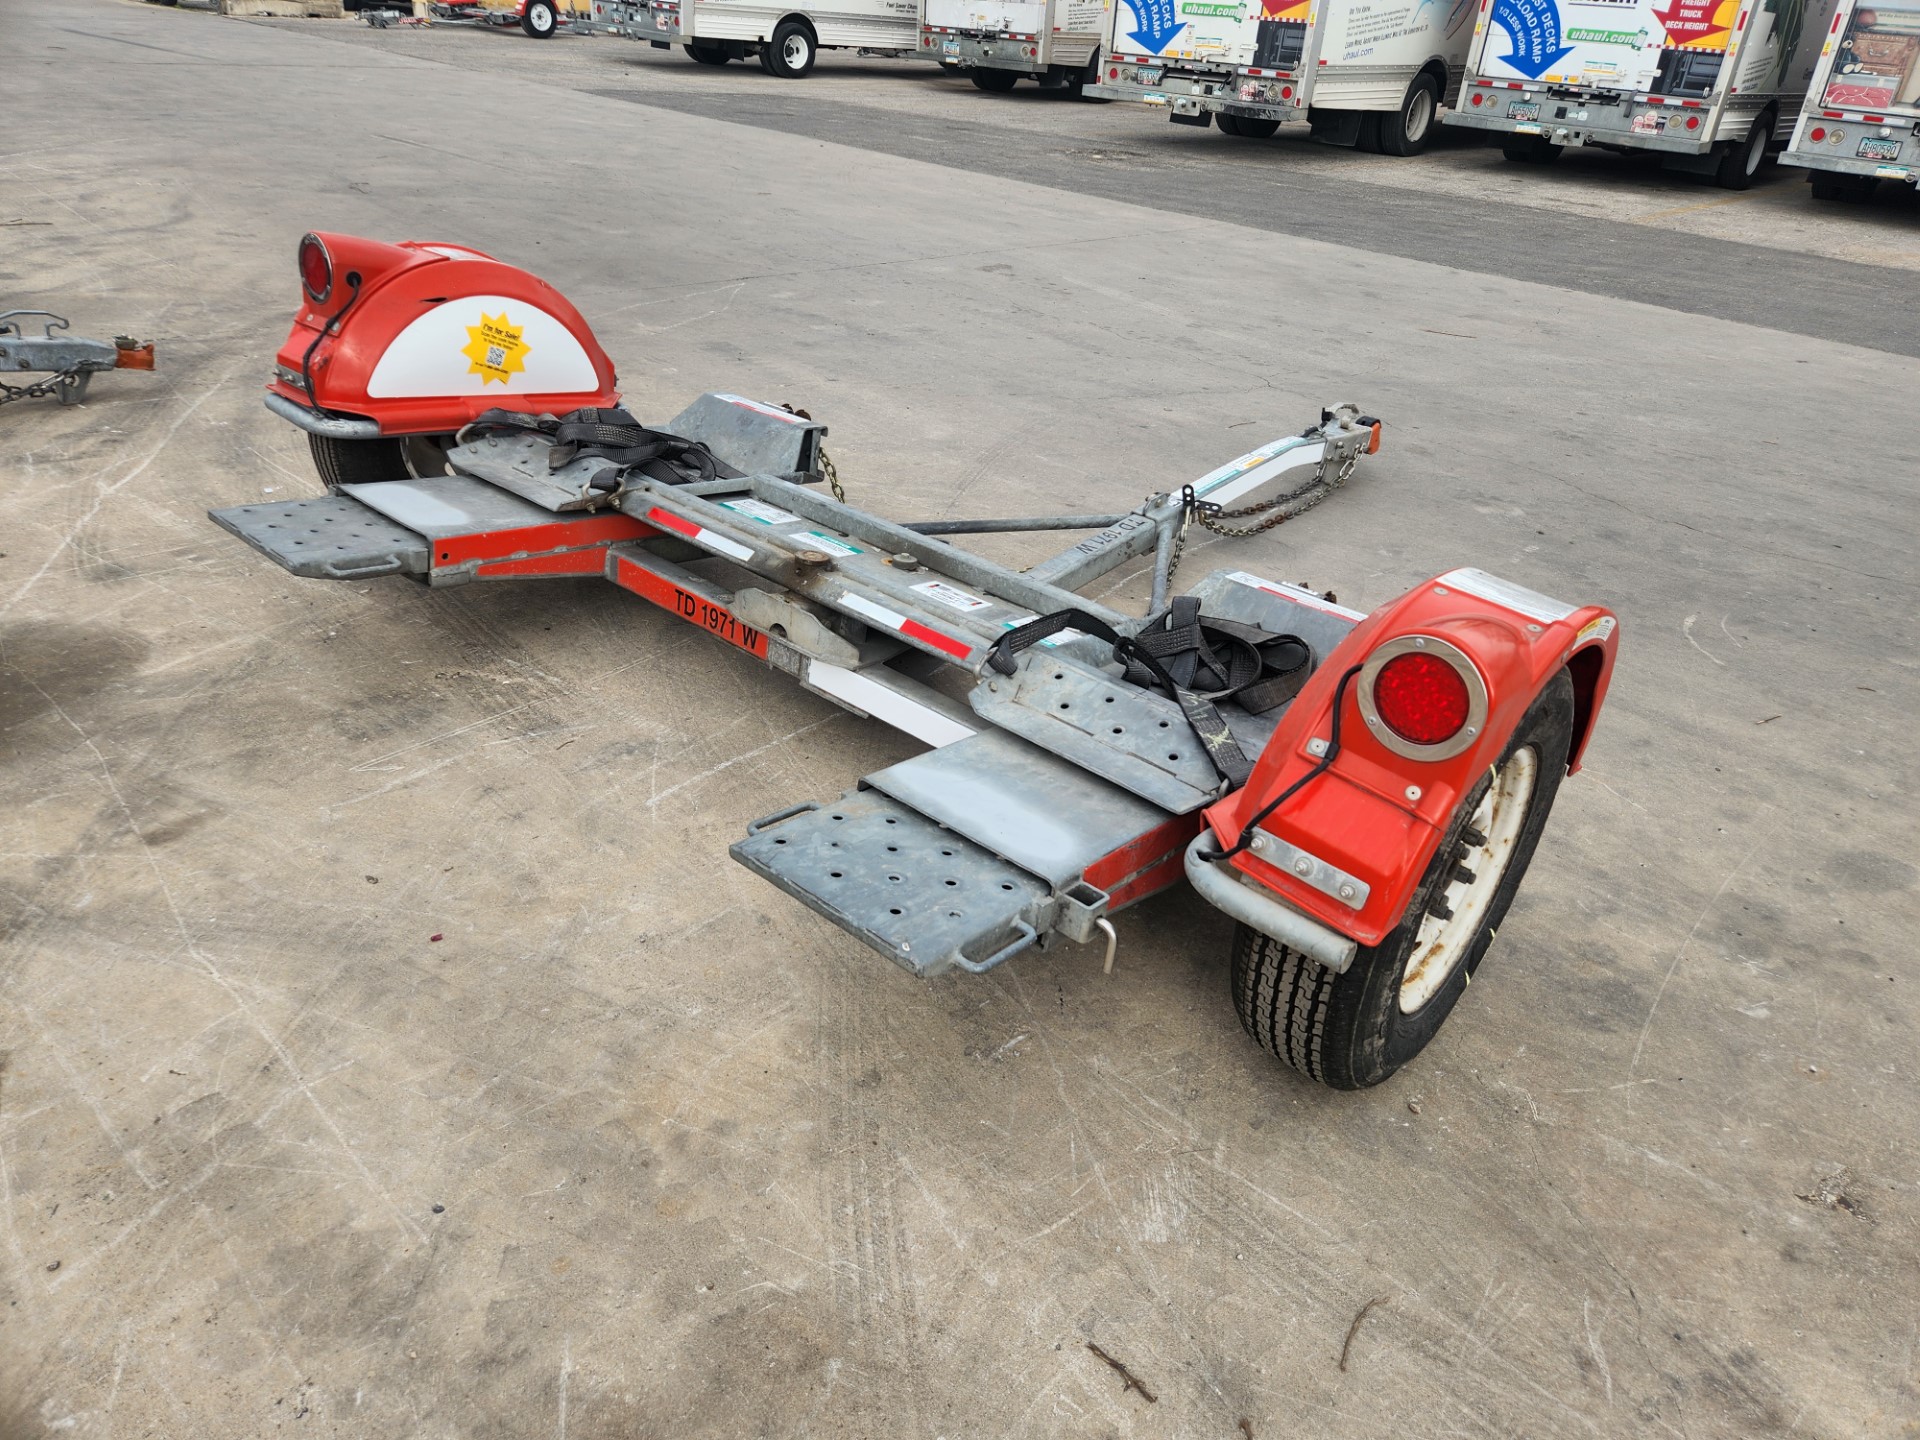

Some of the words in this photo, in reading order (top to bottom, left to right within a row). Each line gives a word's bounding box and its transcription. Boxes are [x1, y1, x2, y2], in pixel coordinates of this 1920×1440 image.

[1185, 5, 1238, 17] uhaul.com
[1679, 9, 1703, 18] TRUCK
[1139, 7, 1148, 33] WORK
[1150, 4, 1161, 39] RAMP
[1665, 20, 1683, 29] DECK
[1683, 22, 1709, 31] HEIGHT
[1498, 6, 1510, 17] 1/3
[1506, 13, 1522, 32] LESS
[1516, 30, 1526, 57] WORK
[1509, 0, 1538, 28] -LOAD
[1531, 28, 1542, 64] RAMP
[1541, 11, 1556, 54] DECKS
[1570, 28, 1637, 44] uhaul.com
[1343, 47, 1374, 60] uhaul.com
[1119, 518, 1146, 531] TD
[1089, 529, 1122, 545] 1971
[1075, 543, 1098, 554] W
[675, 588, 696, 617] TD
[701, 604, 735, 639] 1971
[741, 624, 758, 650] W
